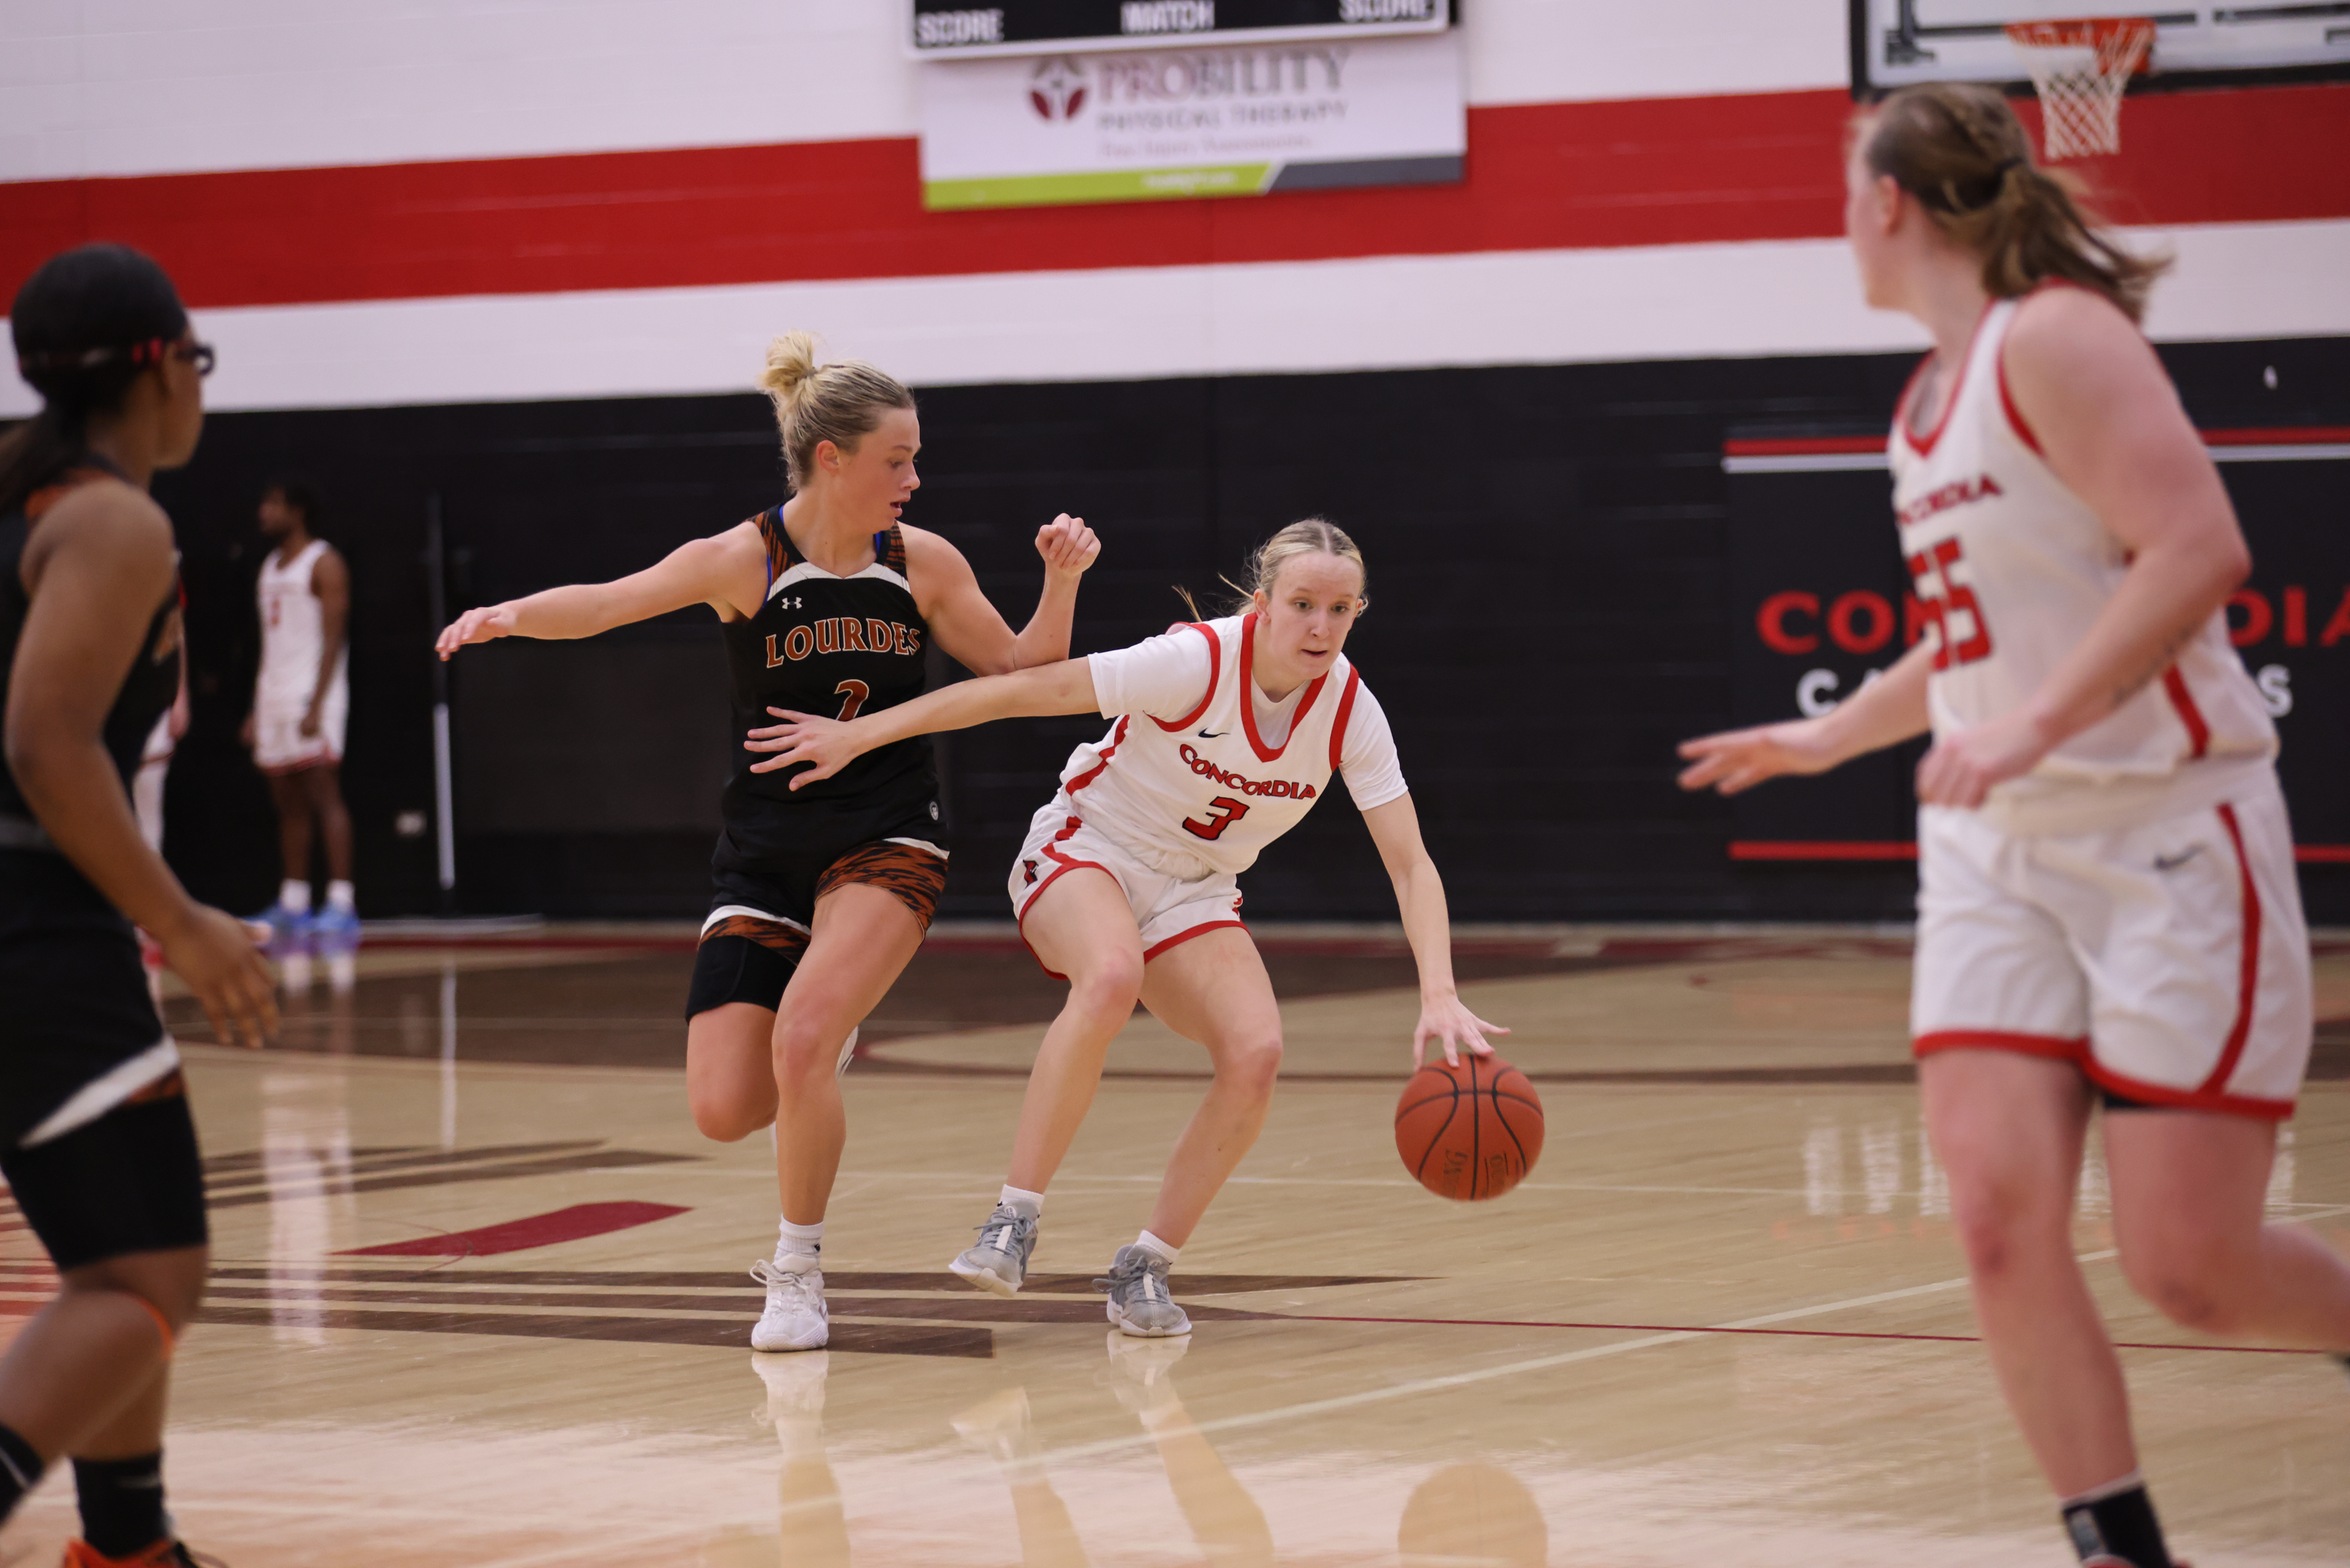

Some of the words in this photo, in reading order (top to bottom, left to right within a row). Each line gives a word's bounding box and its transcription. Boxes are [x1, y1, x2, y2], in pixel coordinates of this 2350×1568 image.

[916, 9, 1003, 46] SCORE
[1121, 0, 1215, 35] MATCH
[1098, 49, 1352, 104] PROBILITY
[766, 617, 921, 669] LOURDES
[1179, 743, 1317, 800] CONCORDIA
[1182, 796, 1250, 840] 3
